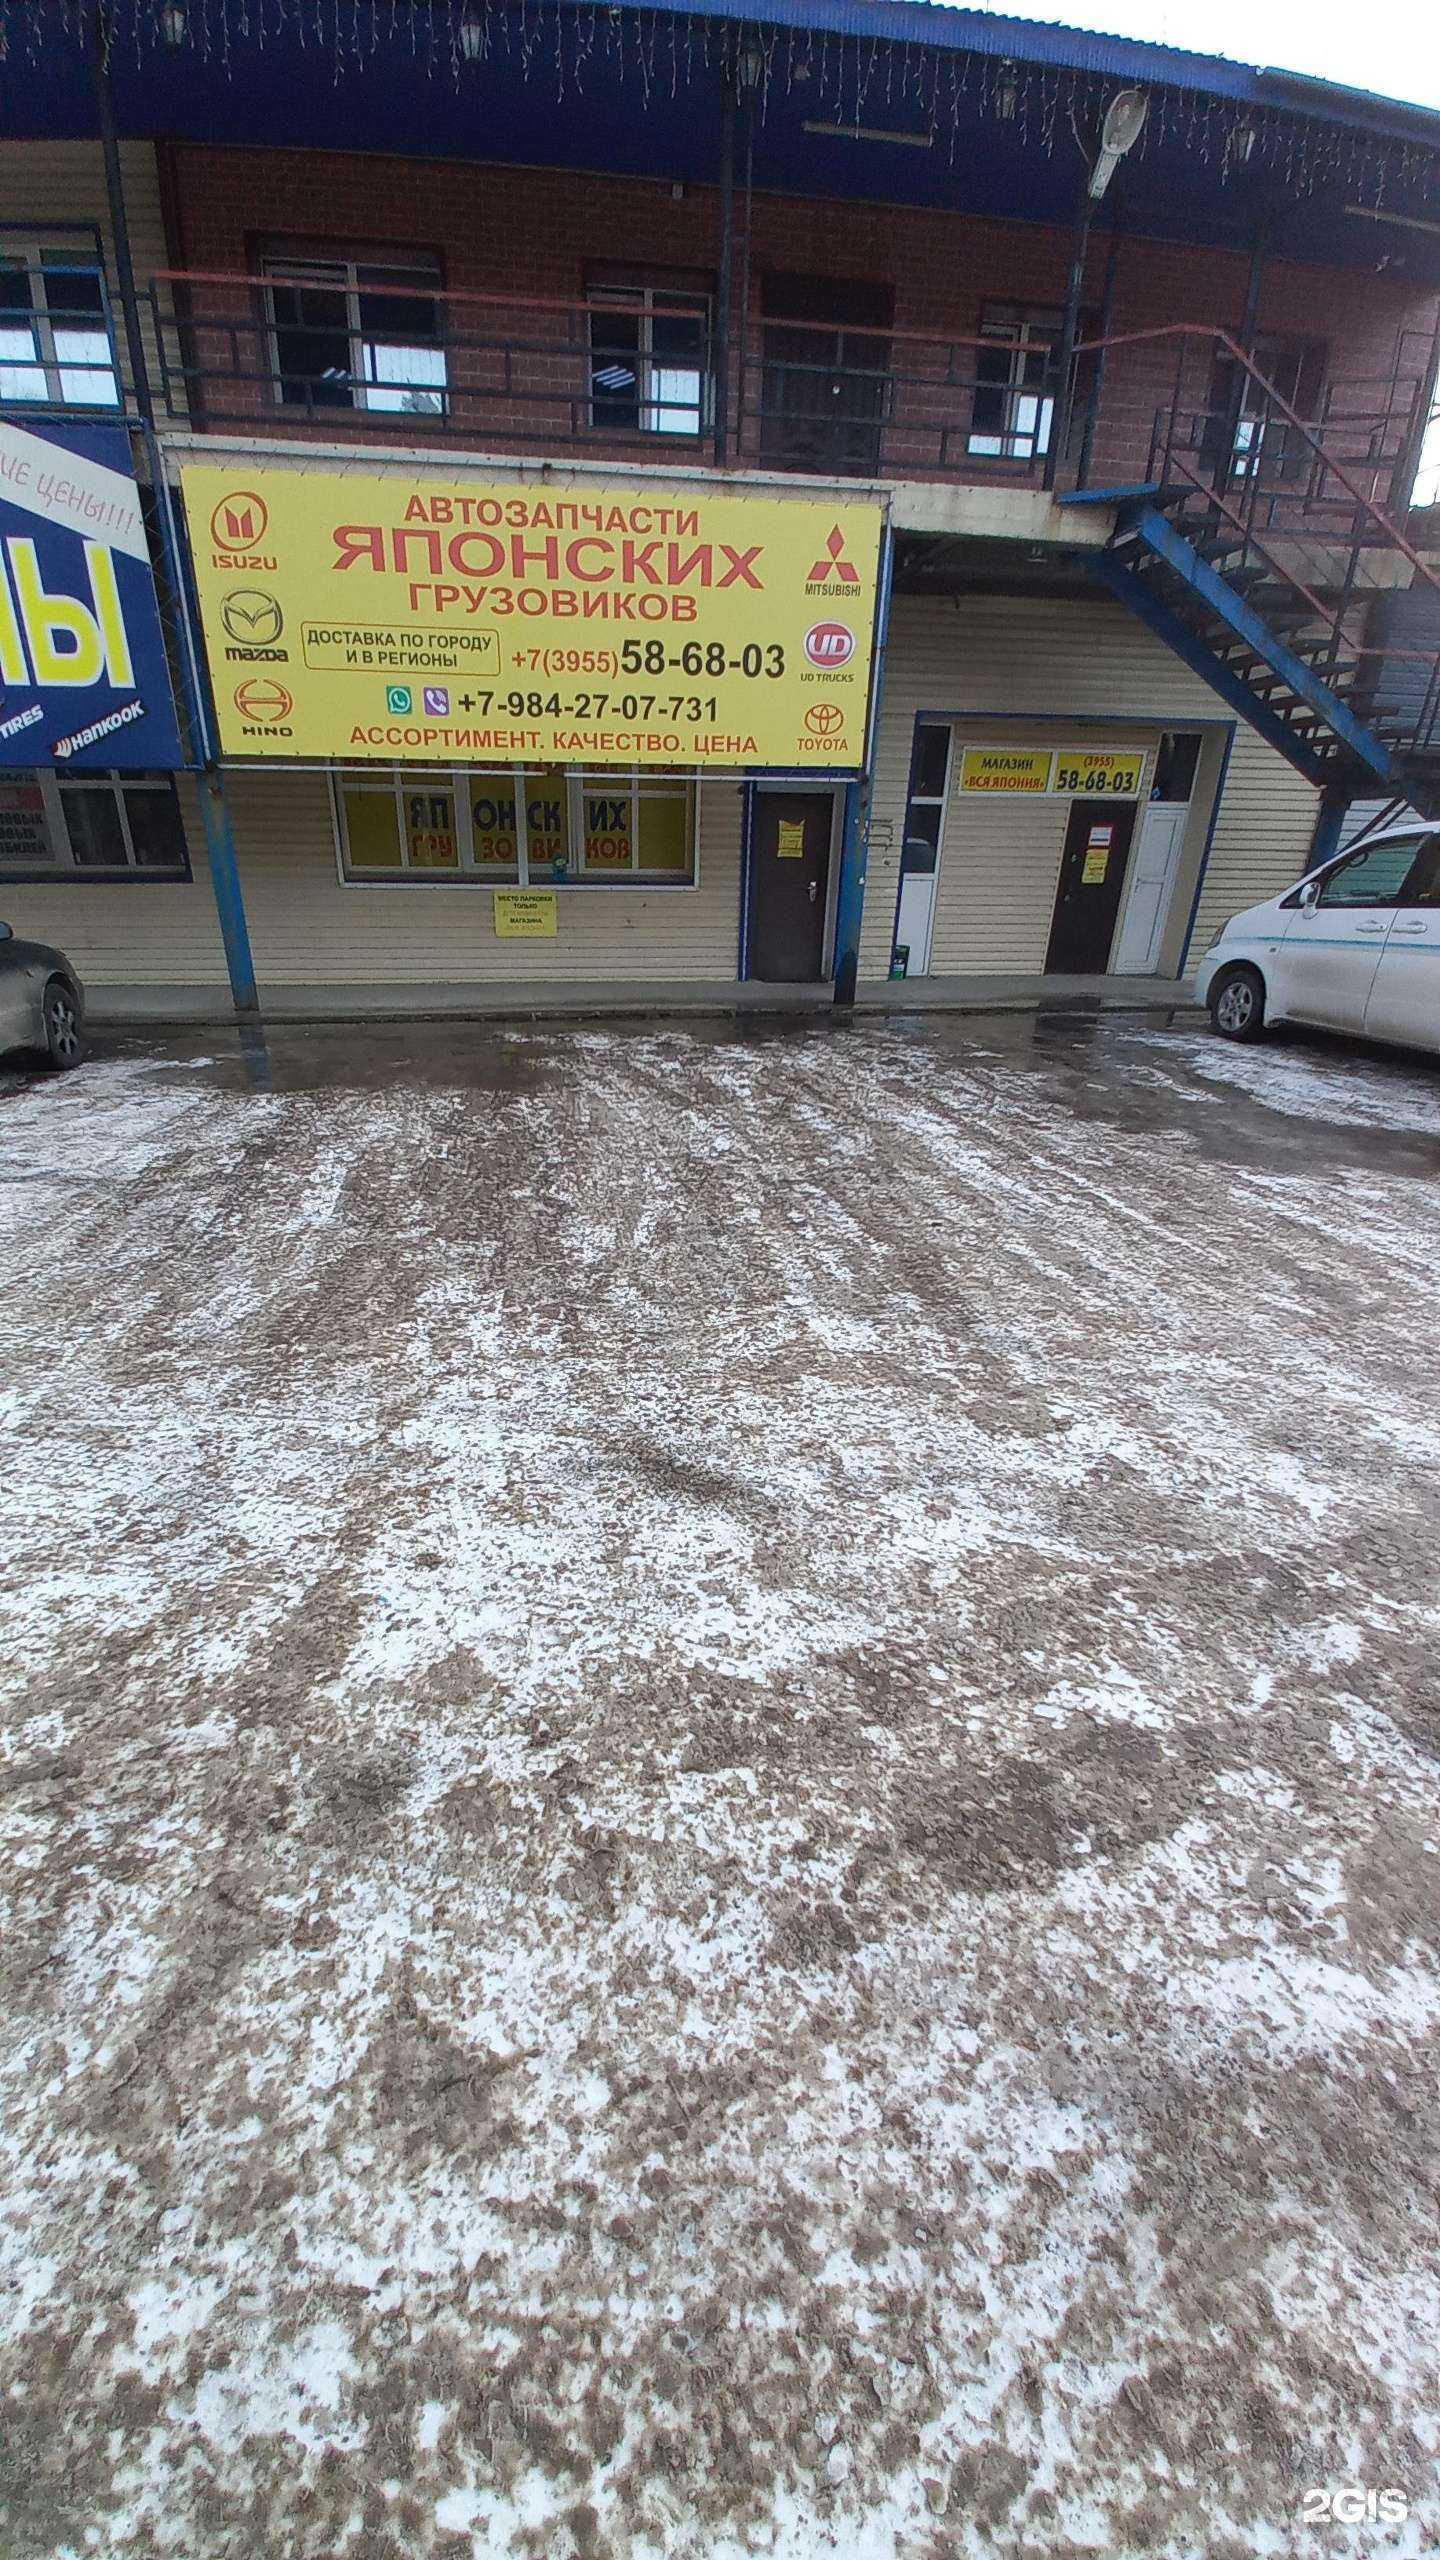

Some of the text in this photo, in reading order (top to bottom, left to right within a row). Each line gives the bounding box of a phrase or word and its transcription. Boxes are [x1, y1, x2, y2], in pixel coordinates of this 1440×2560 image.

[36, 472, 134, 534] ЦЕНЫ!!!
[404, 494, 700, 537] АВТОЗАПЧАСТИ
[212, 554, 278, 571] ISUZU
[331, 525, 765, 590] ЯПОНСКИХ
[804, 583, 861, 597] MITSUBISHI
[408, 582, 700, 623] ГРУЗОВИКОВ
[307, 629, 492, 652] ДОСТАВКА ПО ГОРОДУ
[808, 634, 850, 656] UD
[346, 650, 458, 668] И В РЕГИОНЫ
[800, 672, 855, 684] UD TRUCKS
[457, 690, 718, 723] +7-984-27-07-731
[241, 725, 294, 738] HINO
[349, 726, 759, 756] АССОРТИМЕНТ. КАЧЕСТВО. ЦЕНА
[797, 737, 849, 752] TOYOTA
[980, 757, 1034, 771] МАГАЗИН
[1083, 756, 1115, 768] (3955)
[1056, 768, 1134, 792] 58-68-03
